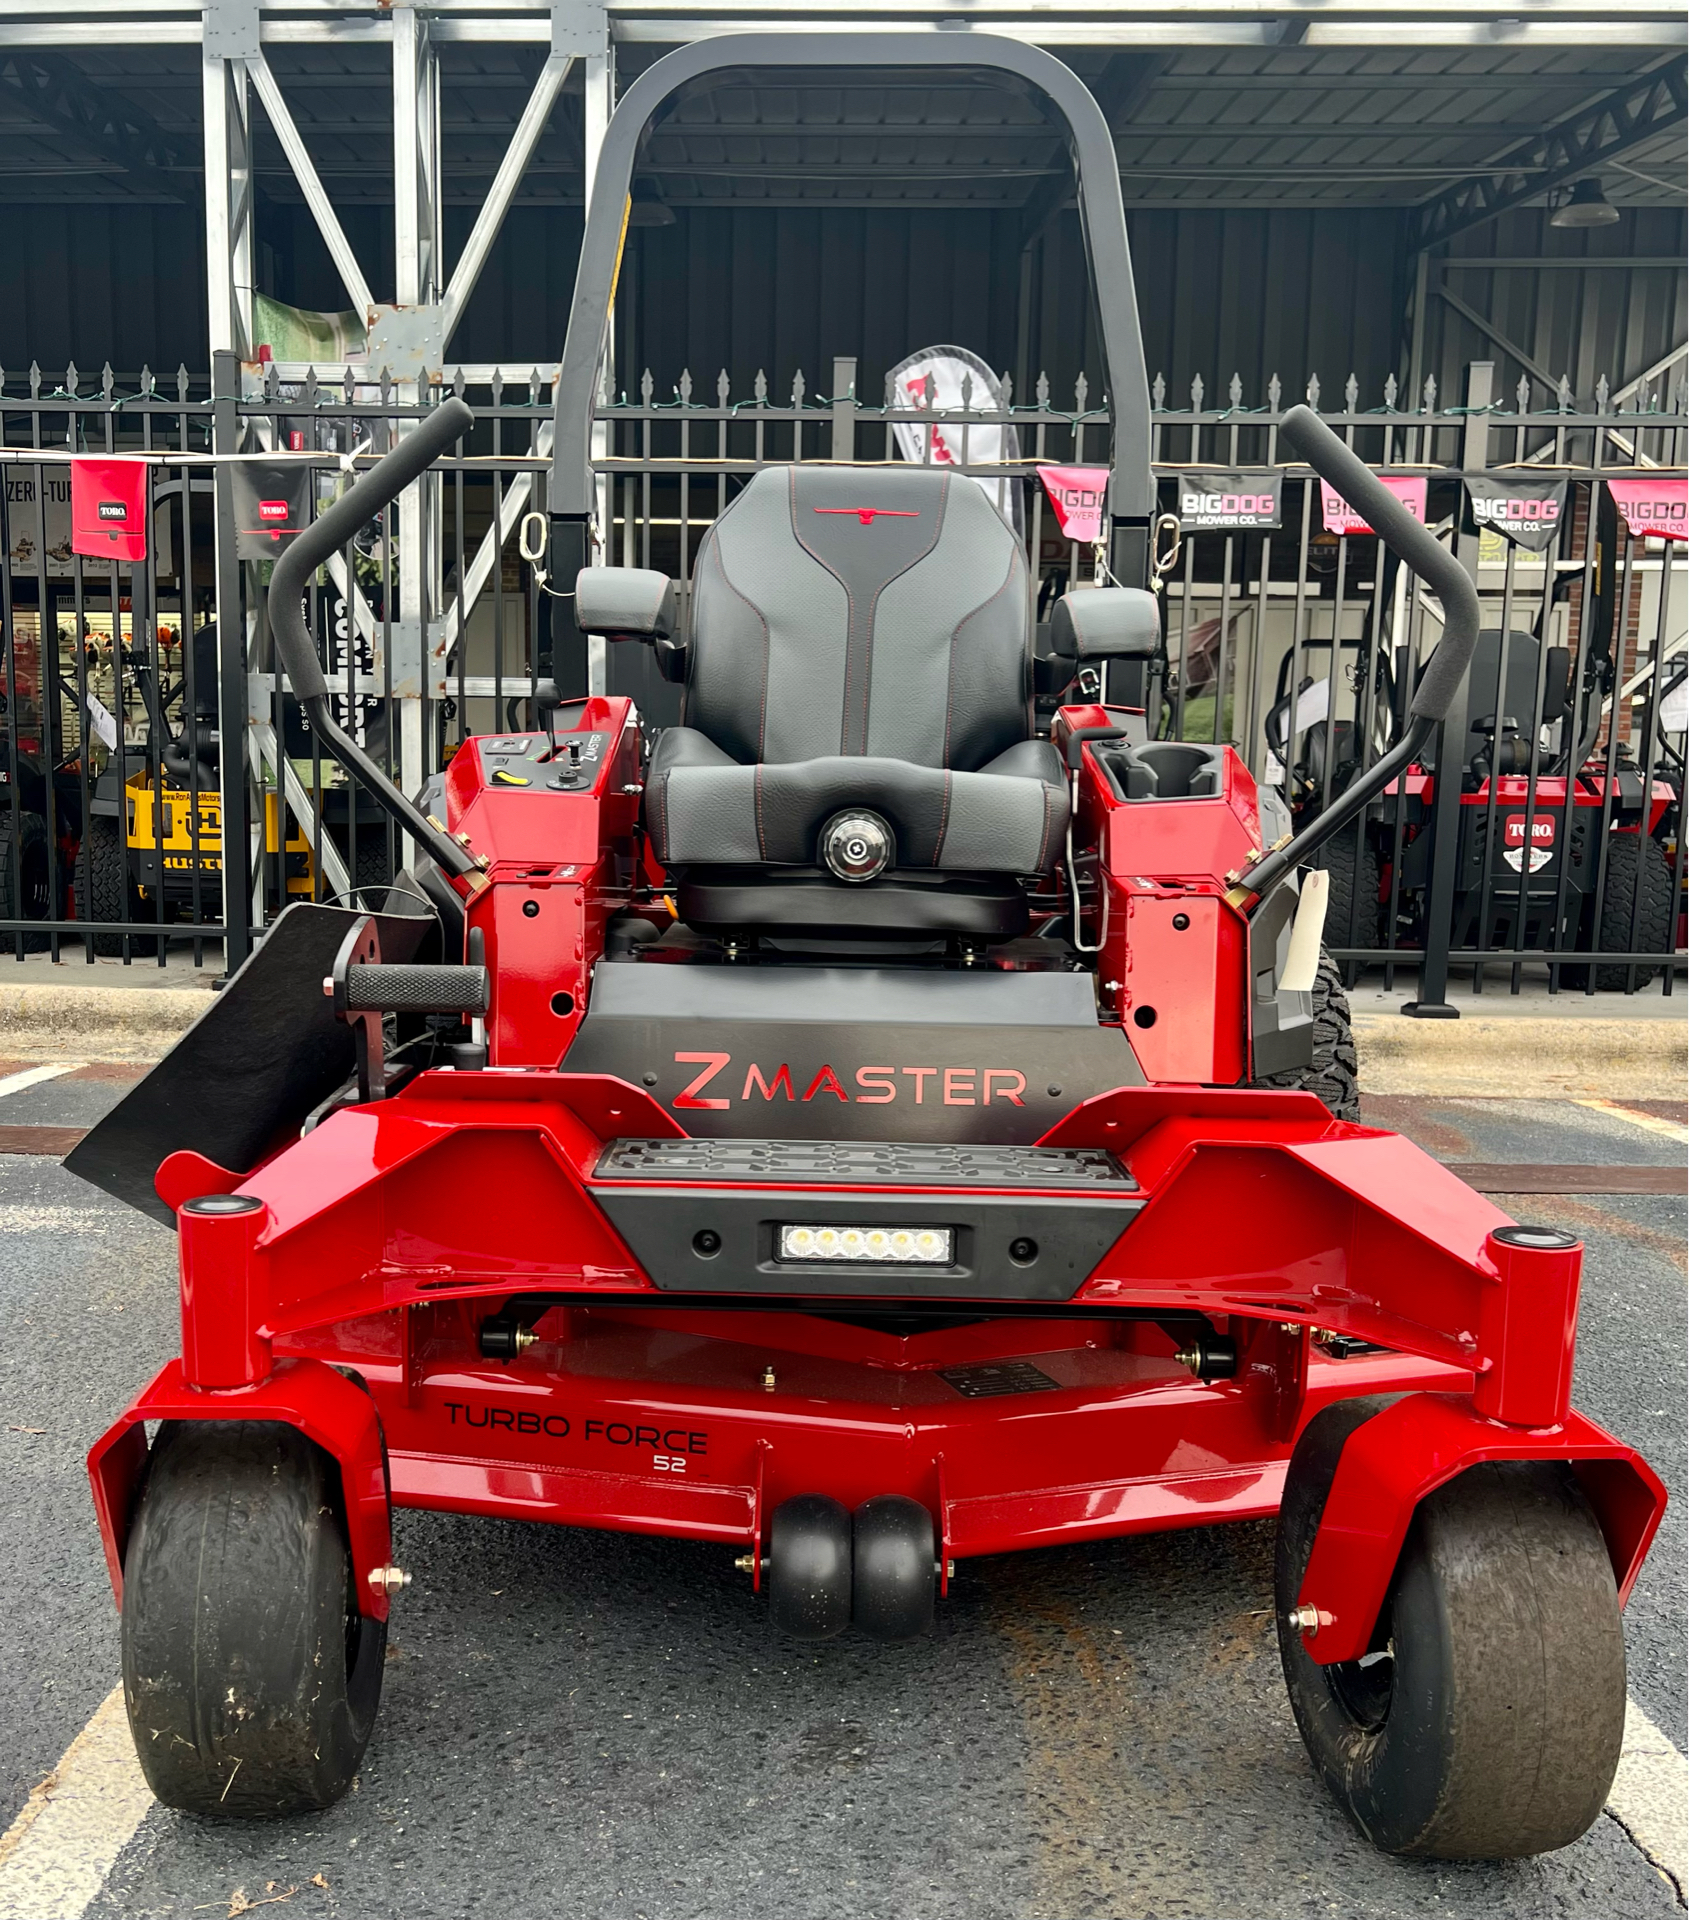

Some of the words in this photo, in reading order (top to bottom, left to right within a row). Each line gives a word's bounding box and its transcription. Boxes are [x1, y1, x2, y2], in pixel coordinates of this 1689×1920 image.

[99, 506, 126, 516] TORO
[261, 505, 286, 515] TORO
[1182, 493, 1274, 515] BIGDOG
[1472, 497, 1559, 520] BIGDOG
[1616, 500, 1688, 520] BIGDO
[1197, 515, 1237, 525] MOWER
[1239, 515, 1257, 525] CO.
[740, 1062, 1028, 1107] MASTER
[444, 1402, 571, 1438] TURBO
[584, 1419, 709, 1456] FORCE
[653, 1454, 687, 1473] 52
